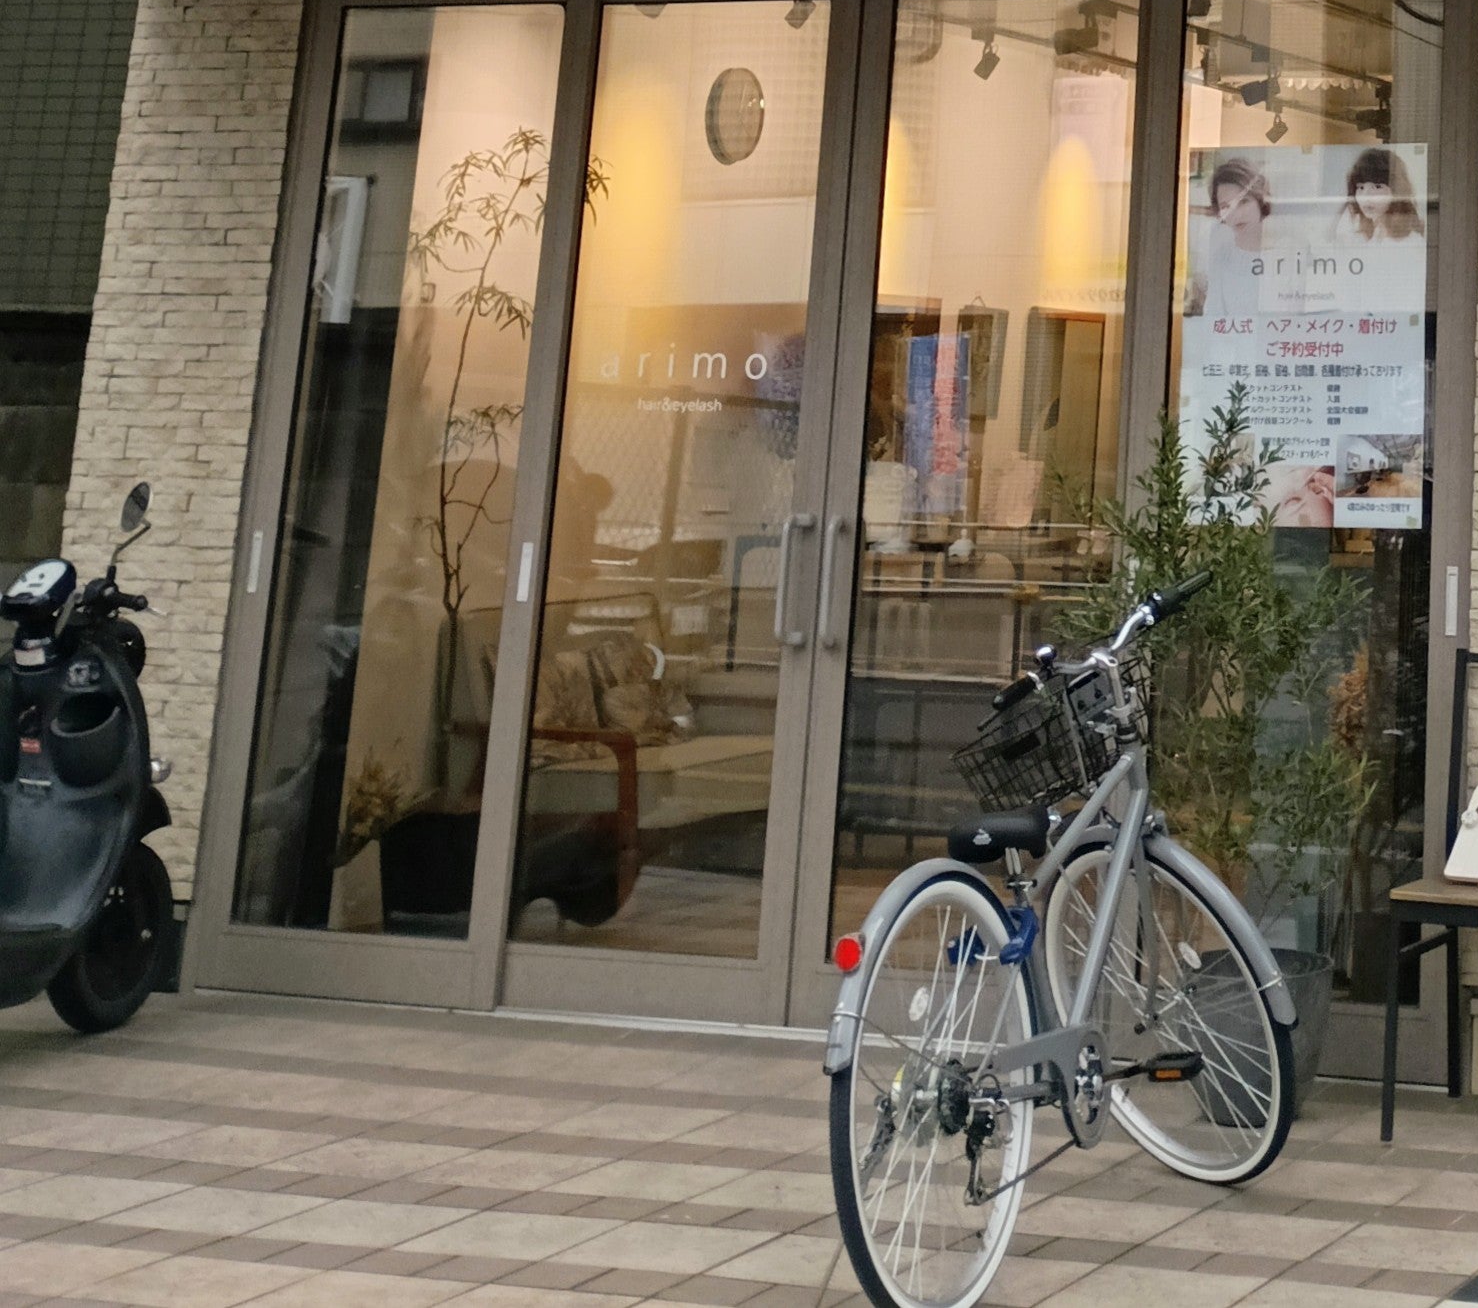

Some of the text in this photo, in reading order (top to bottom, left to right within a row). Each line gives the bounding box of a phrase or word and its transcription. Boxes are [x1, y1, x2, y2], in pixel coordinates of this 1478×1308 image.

[1251, 252, 1365, 276] arimo
[1213, 318, 1253, 334] 成人式
[1266, 341, 1345, 358] ご予約受付中
[601, 343, 769, 381] arimo
